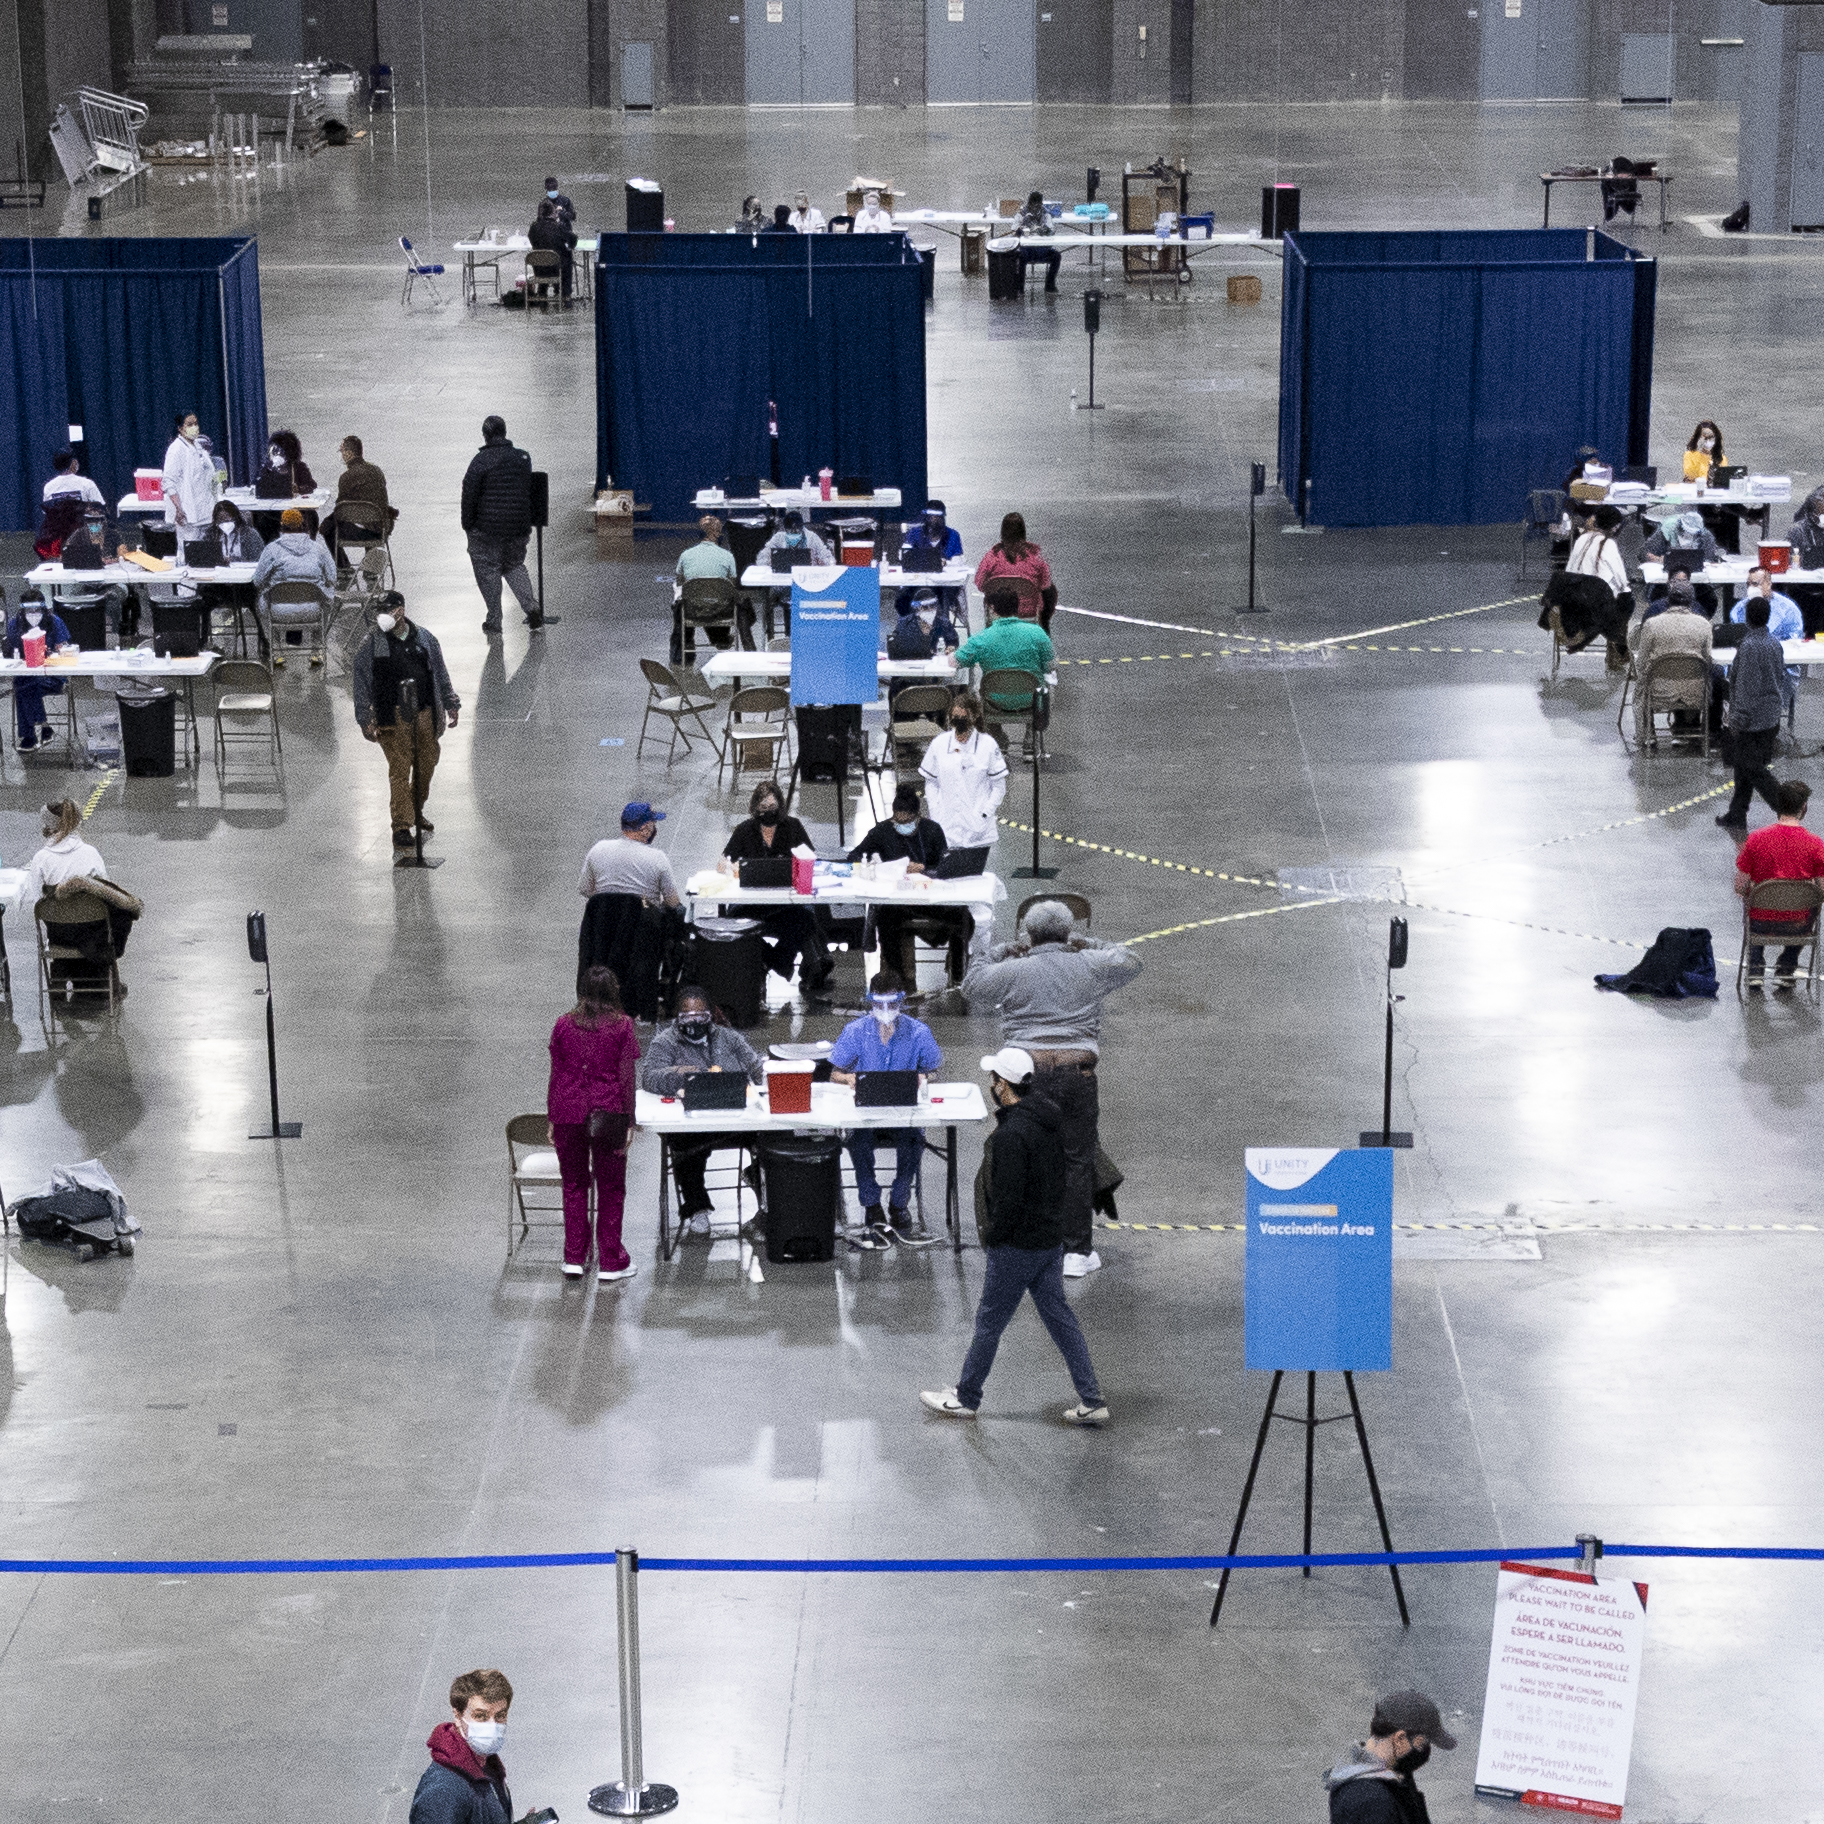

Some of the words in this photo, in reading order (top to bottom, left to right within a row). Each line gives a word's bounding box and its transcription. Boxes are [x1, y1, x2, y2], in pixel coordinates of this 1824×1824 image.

[1259, 1221, 1338, 1235] Vaccination
[1341, 1222, 1375, 1235] Area
[1528, 1583, 1591, 1600] VACCINATION
[1593, 1594, 1617, 1604] AREA
[1508, 1593, 1542, 1605] PLEASE
[1545, 1599, 1567, 1609] WAIT
[1570, 1603, 1583, 1612] TO
[1584, 1605, 1596, 1614] BE
[1597, 1607, 1635, 1621] CALLED
[1543, 1618, 1555, 1627] DE
[1510, 1627, 1545, 1640] ESPERE
[1548, 1633, 1554, 1641] A
[1556, 1634, 1575, 1645] SER
